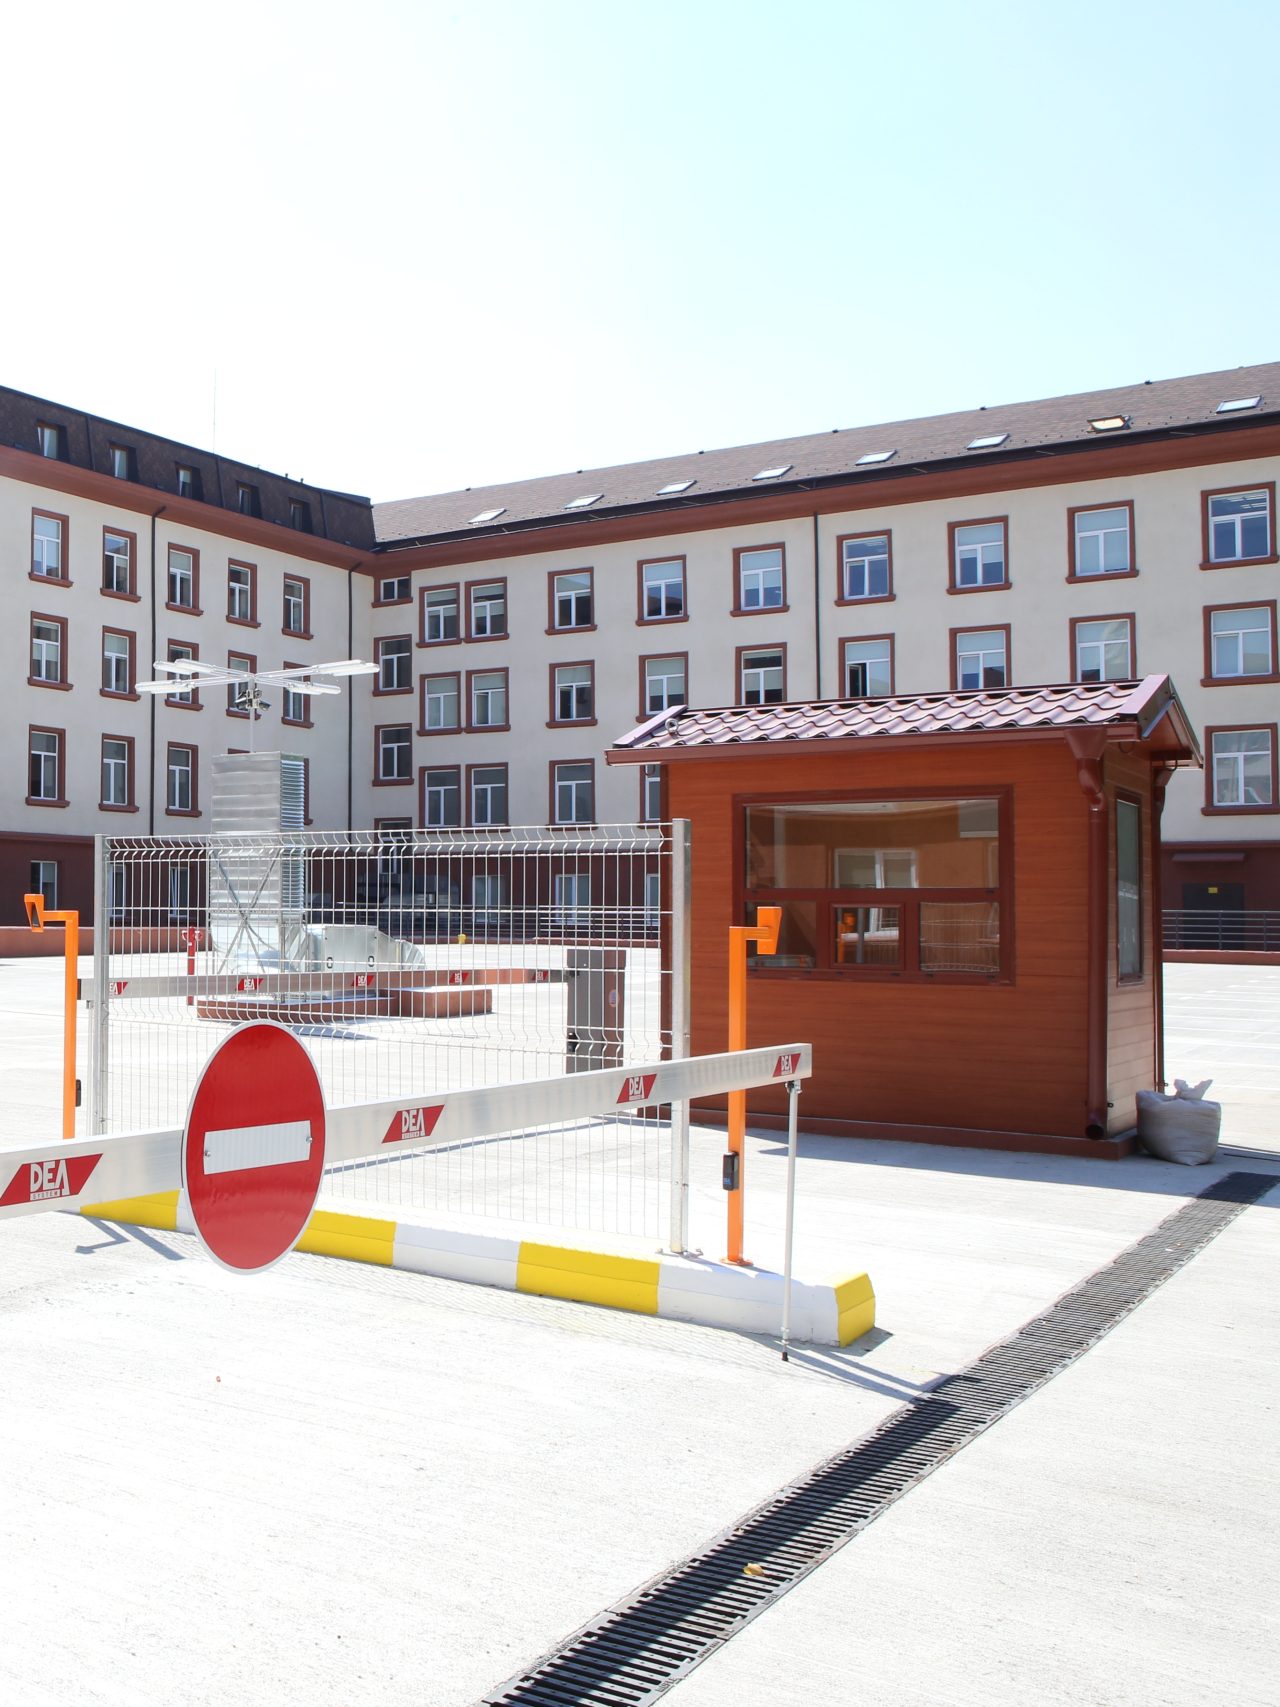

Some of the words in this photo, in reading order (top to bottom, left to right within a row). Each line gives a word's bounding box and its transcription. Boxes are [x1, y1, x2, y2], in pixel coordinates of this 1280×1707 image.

[629, 1076, 645, 1099] DEA
[401, 1108, 426, 1136] DEA
[30, 1159, 70, 1196] DEA
